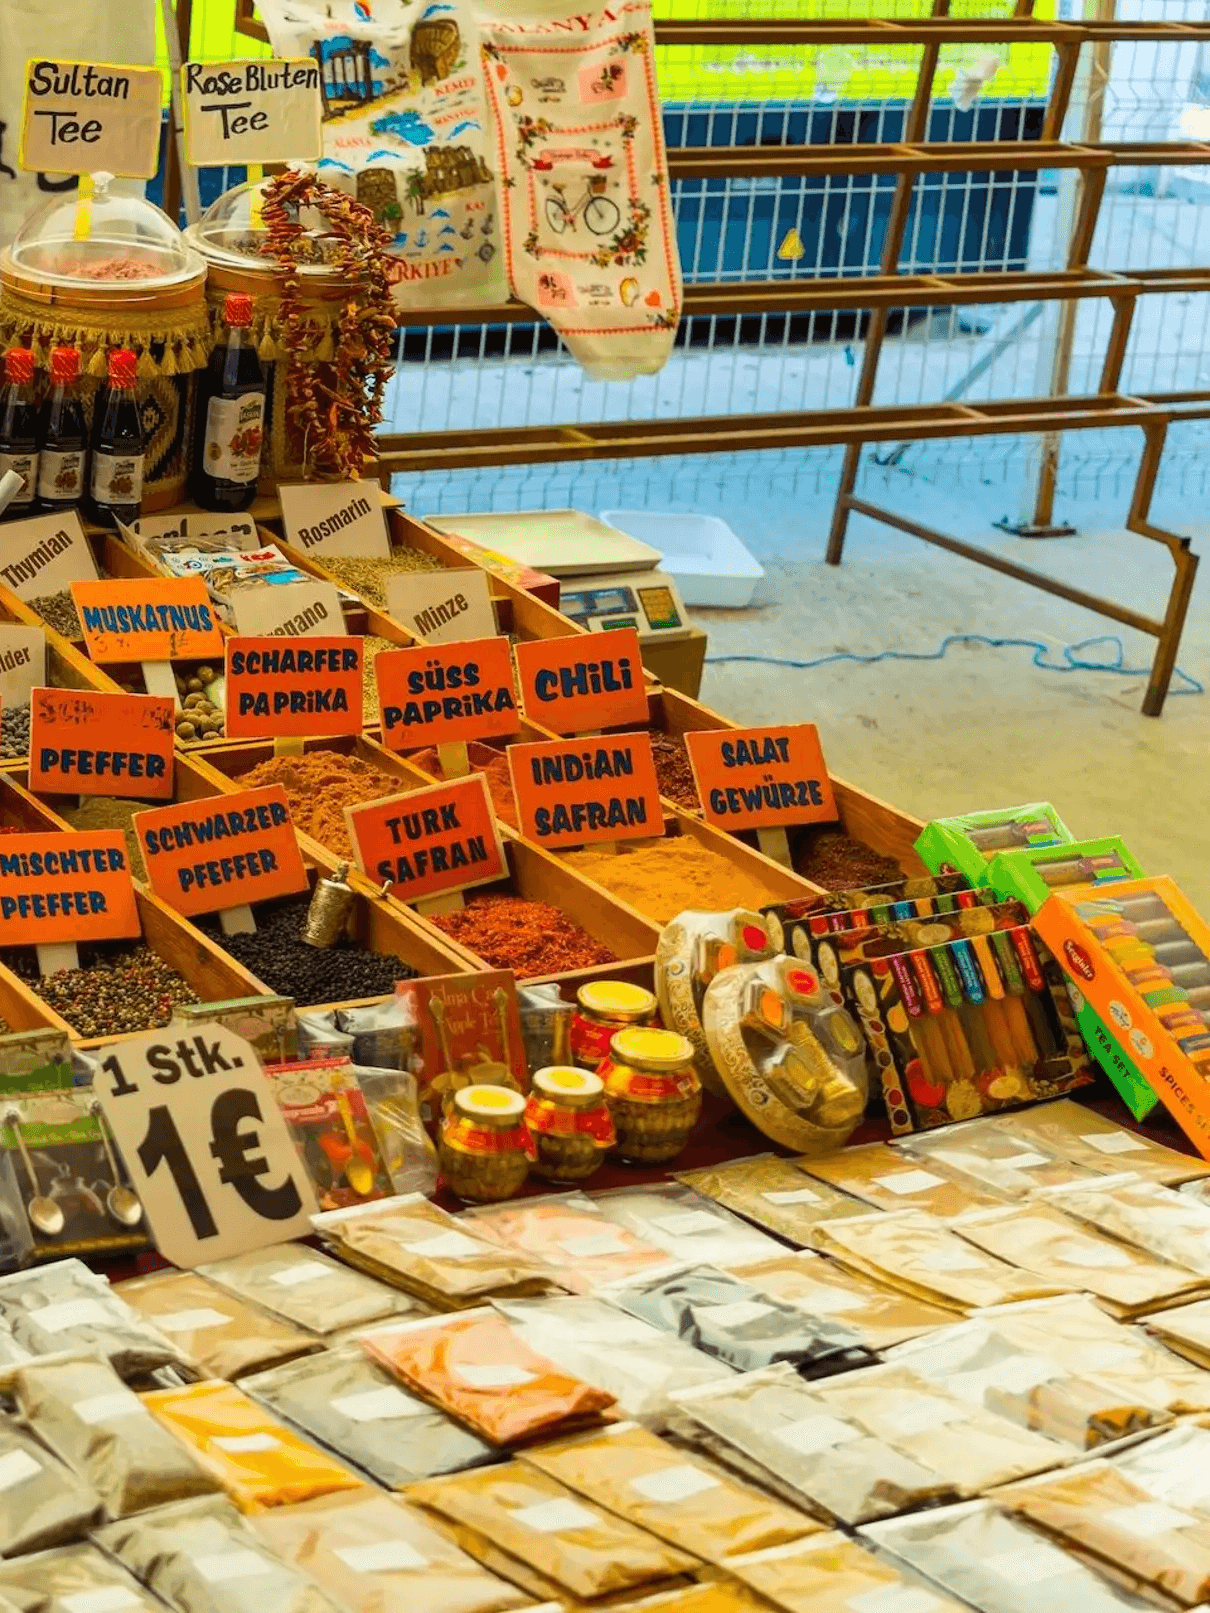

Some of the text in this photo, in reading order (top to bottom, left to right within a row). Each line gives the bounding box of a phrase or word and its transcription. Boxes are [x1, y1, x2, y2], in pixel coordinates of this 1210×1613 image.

[29, 61, 130, 99] Sultan
[187, 64, 320, 95] Rose Bluten
[34, 110, 102, 145] Tee
[201, 102, 268, 139] Tee
[298, 497, 372, 549] Rosmarin
[0, 529, 73, 589] Thymian
[82, 604, 213, 633] MUSKATNUS
[257, 601, 328, 636] egano
[413, 593, 469, 637] Minze
[231, 648, 359, 675] SCHARFER
[40, 748, 166, 778] PFEFFER
[721, 736, 791, 768] SALAT
[709, 775, 824, 815] GEWÜRZE
[144, 802, 288, 855] SCHWARZER
[384, 802, 462, 844] TURK
[533, 796, 647, 837] SAFRAN
[176, 849, 278, 892] PFEFFER
[376, 835, 488, 885] SAFRAN
[0, 891, 108, 920] PFEFFER
[102, 1036, 244, 1097] 1 Stk.
[1158, 1066, 1196, 1115] SPICES
